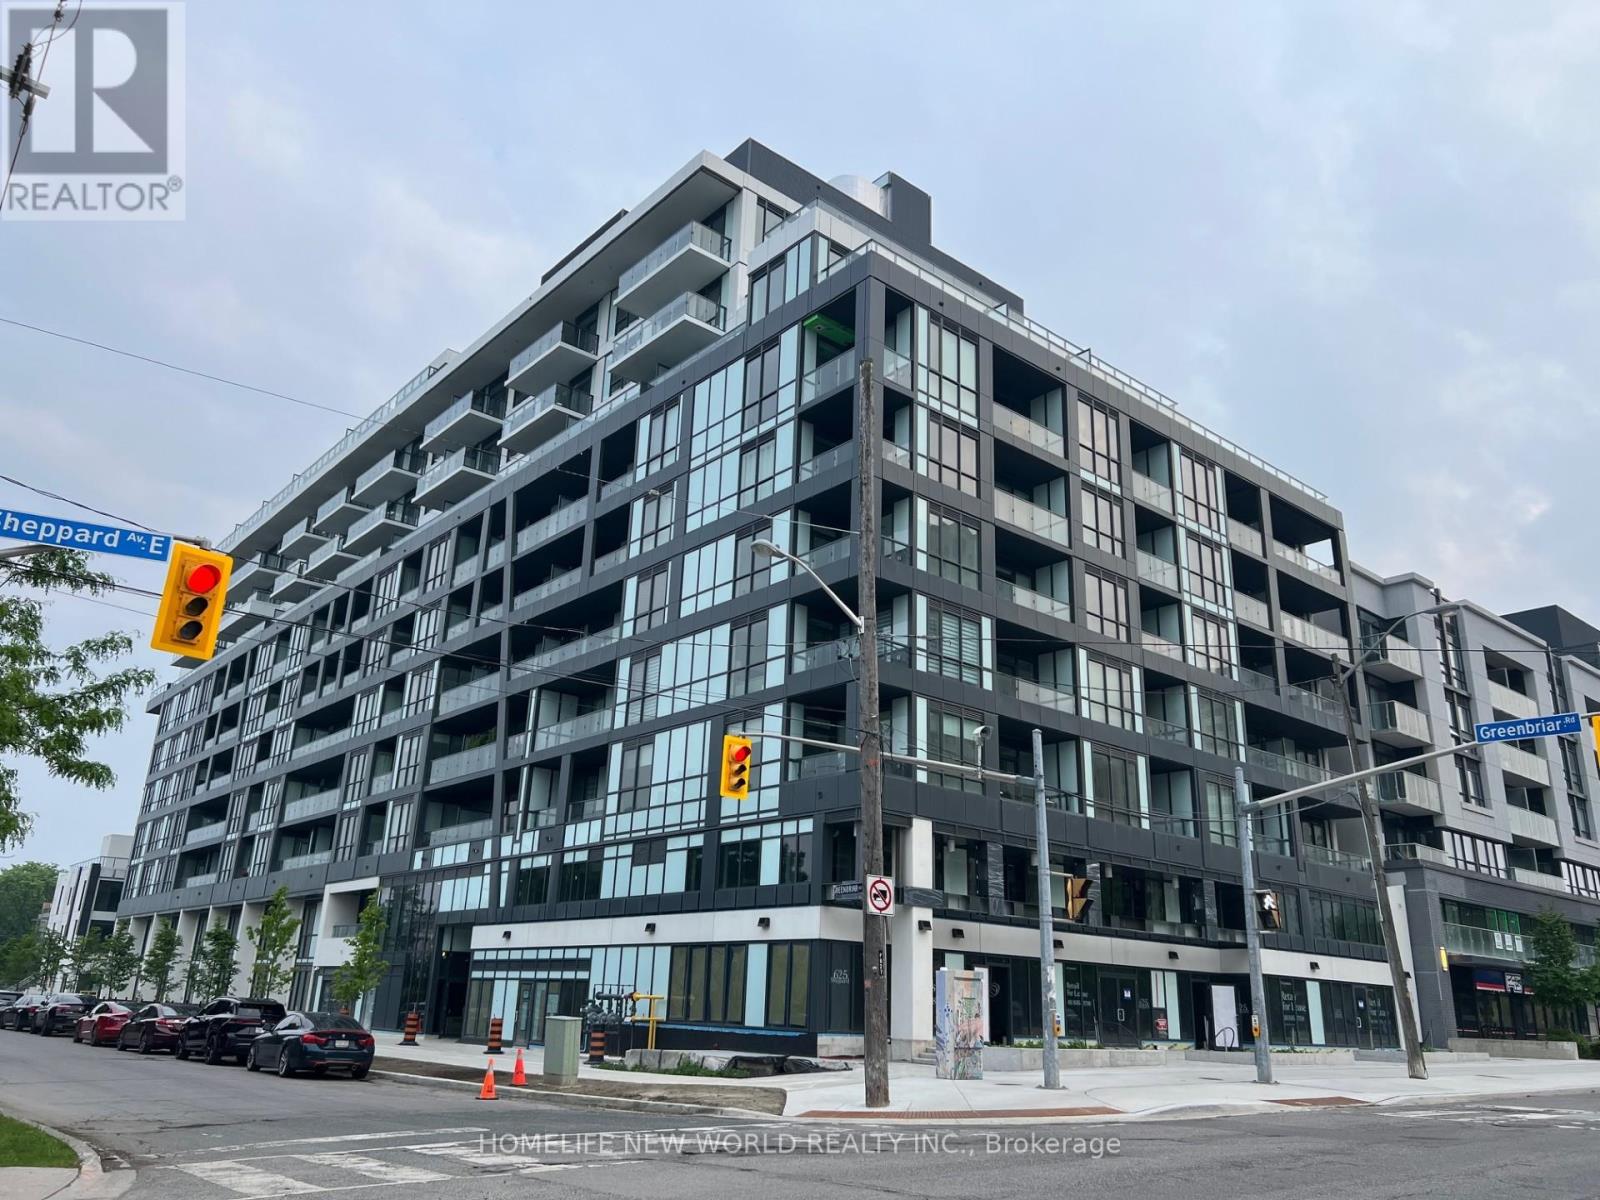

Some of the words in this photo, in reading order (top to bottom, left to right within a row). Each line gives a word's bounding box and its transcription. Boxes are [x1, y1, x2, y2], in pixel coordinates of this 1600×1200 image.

[0, 512, 120, 548] heppard
[149, 536, 165, 555] E
[1480, 720, 1562, 739] Greenbriar
[833, 969, 848, 980] 625
